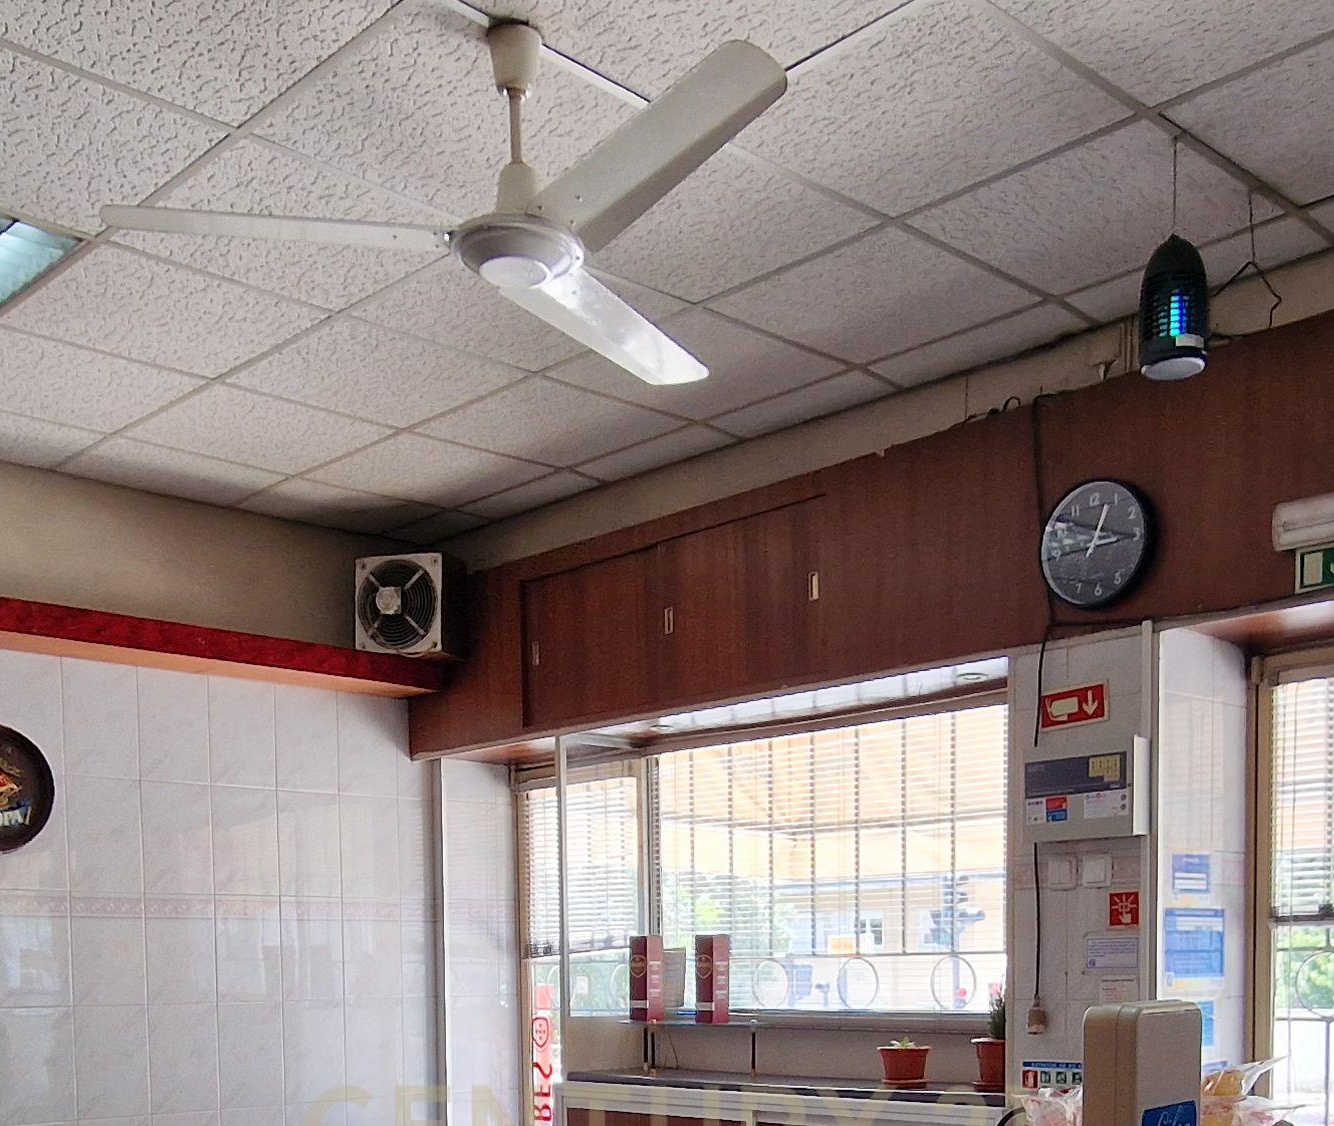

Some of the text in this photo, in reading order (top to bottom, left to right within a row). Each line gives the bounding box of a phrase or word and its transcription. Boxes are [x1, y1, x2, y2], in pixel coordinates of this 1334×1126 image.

[1089, 492, 1100, 507] 12
[1128, 506, 1137, 519] 2
[1074, 583, 1083, 594] 7
[1094, 582, 1103, 597] 6
